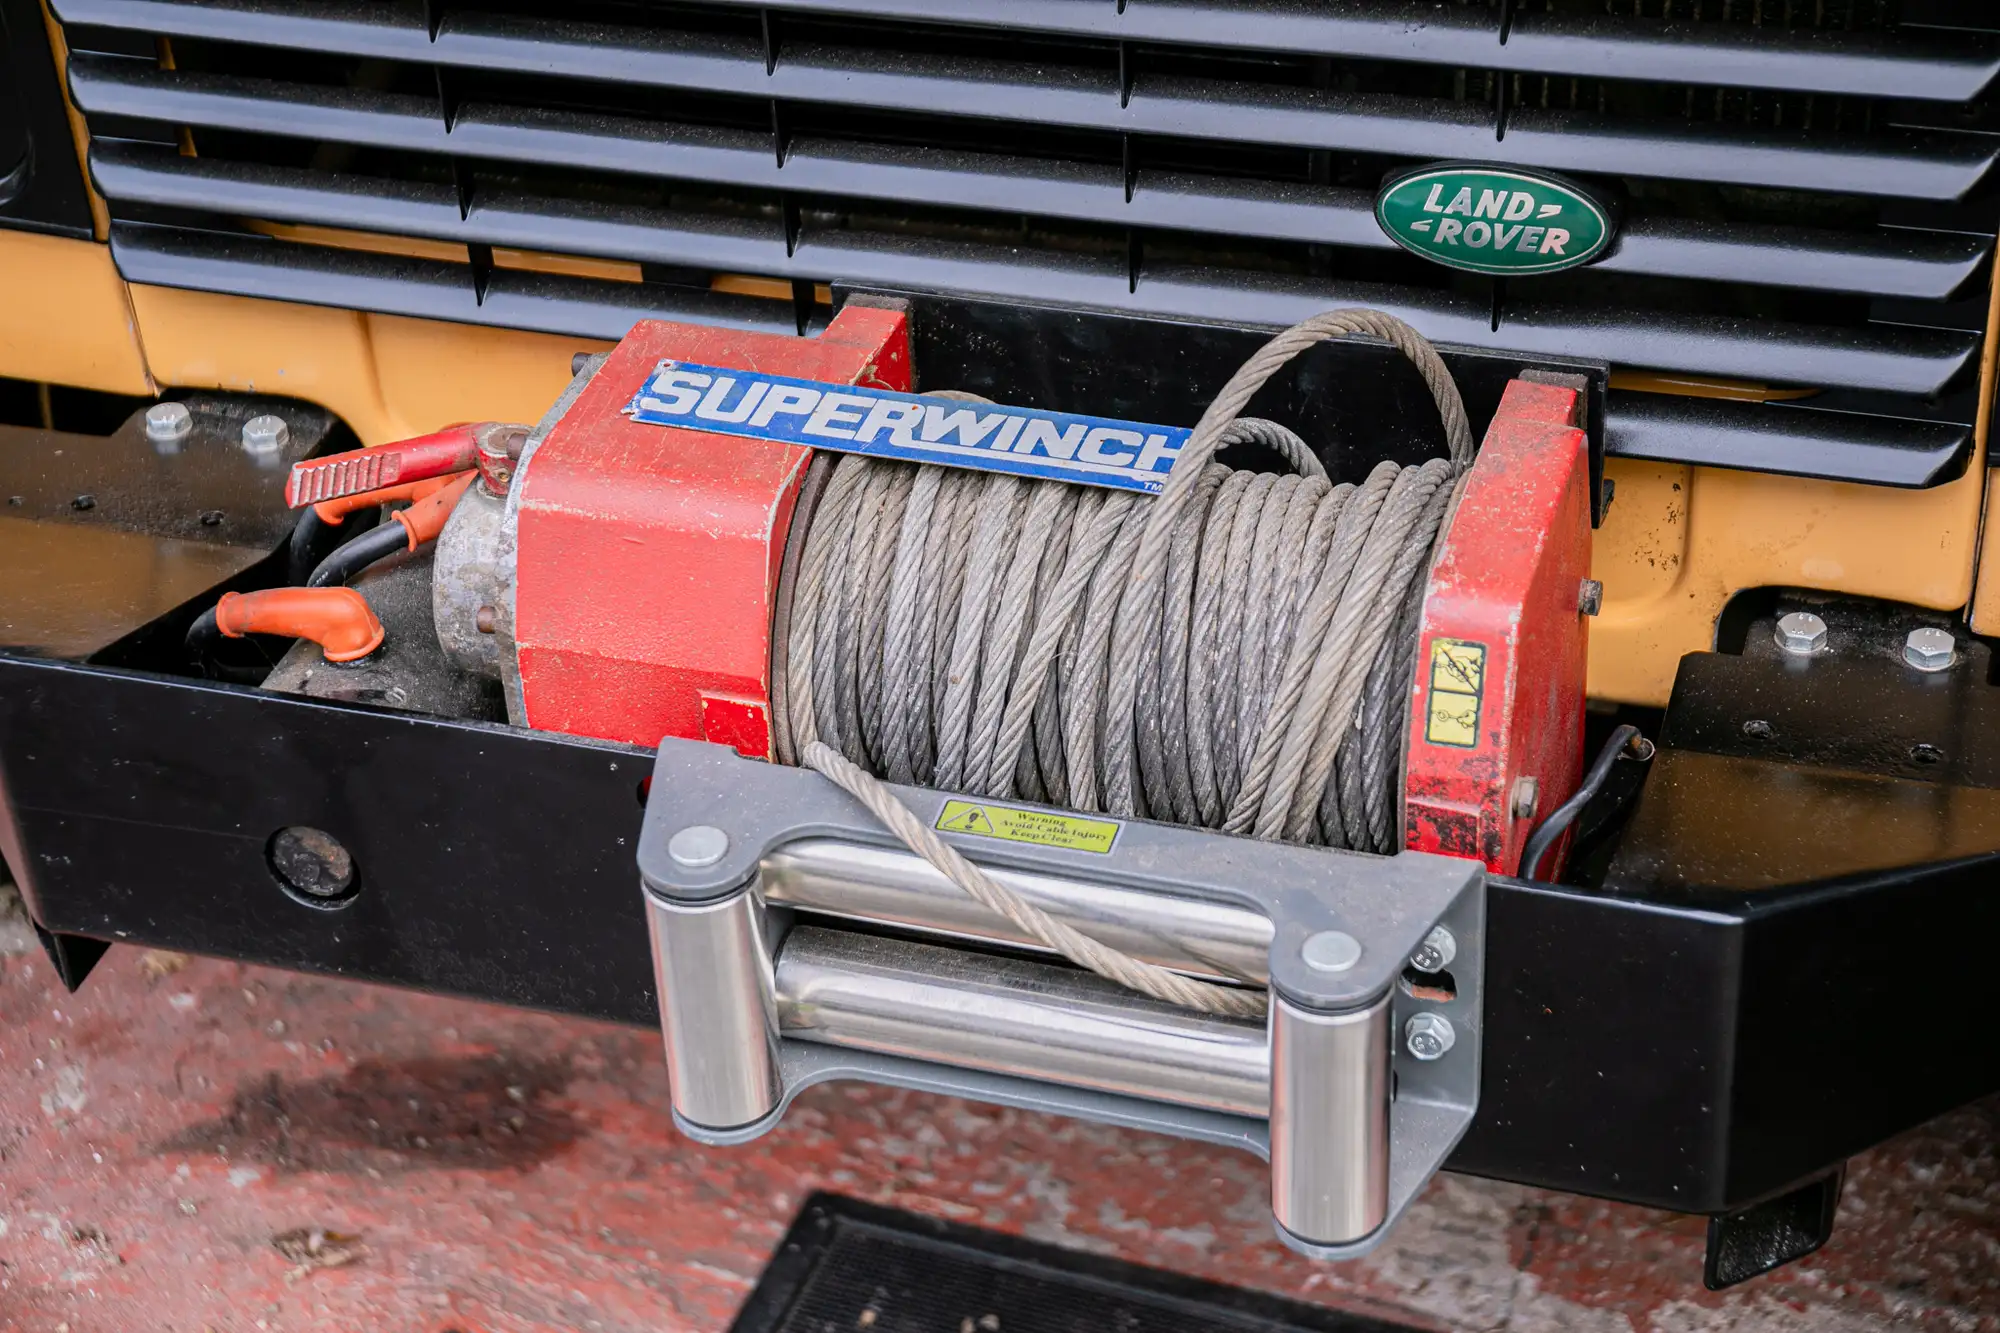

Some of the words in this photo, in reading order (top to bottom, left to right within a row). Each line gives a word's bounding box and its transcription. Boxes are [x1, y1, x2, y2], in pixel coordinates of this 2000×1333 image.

[1423, 183, 1535, 221] LAND
[1433, 217, 1571, 255] ROVER
[640, 370, 1188, 474] SUPERWINCH
[1144, 482, 1164, 491] TM
[1000, 819, 1033, 830] Avoid
[1037, 824, 1071, 835] Cable
[1072, 828, 1109, 842] Injury
[1017, 812, 1067, 827] Warning
[1010, 828, 1040, 840] Keep
[1041, 833, 1075, 844] Clear
